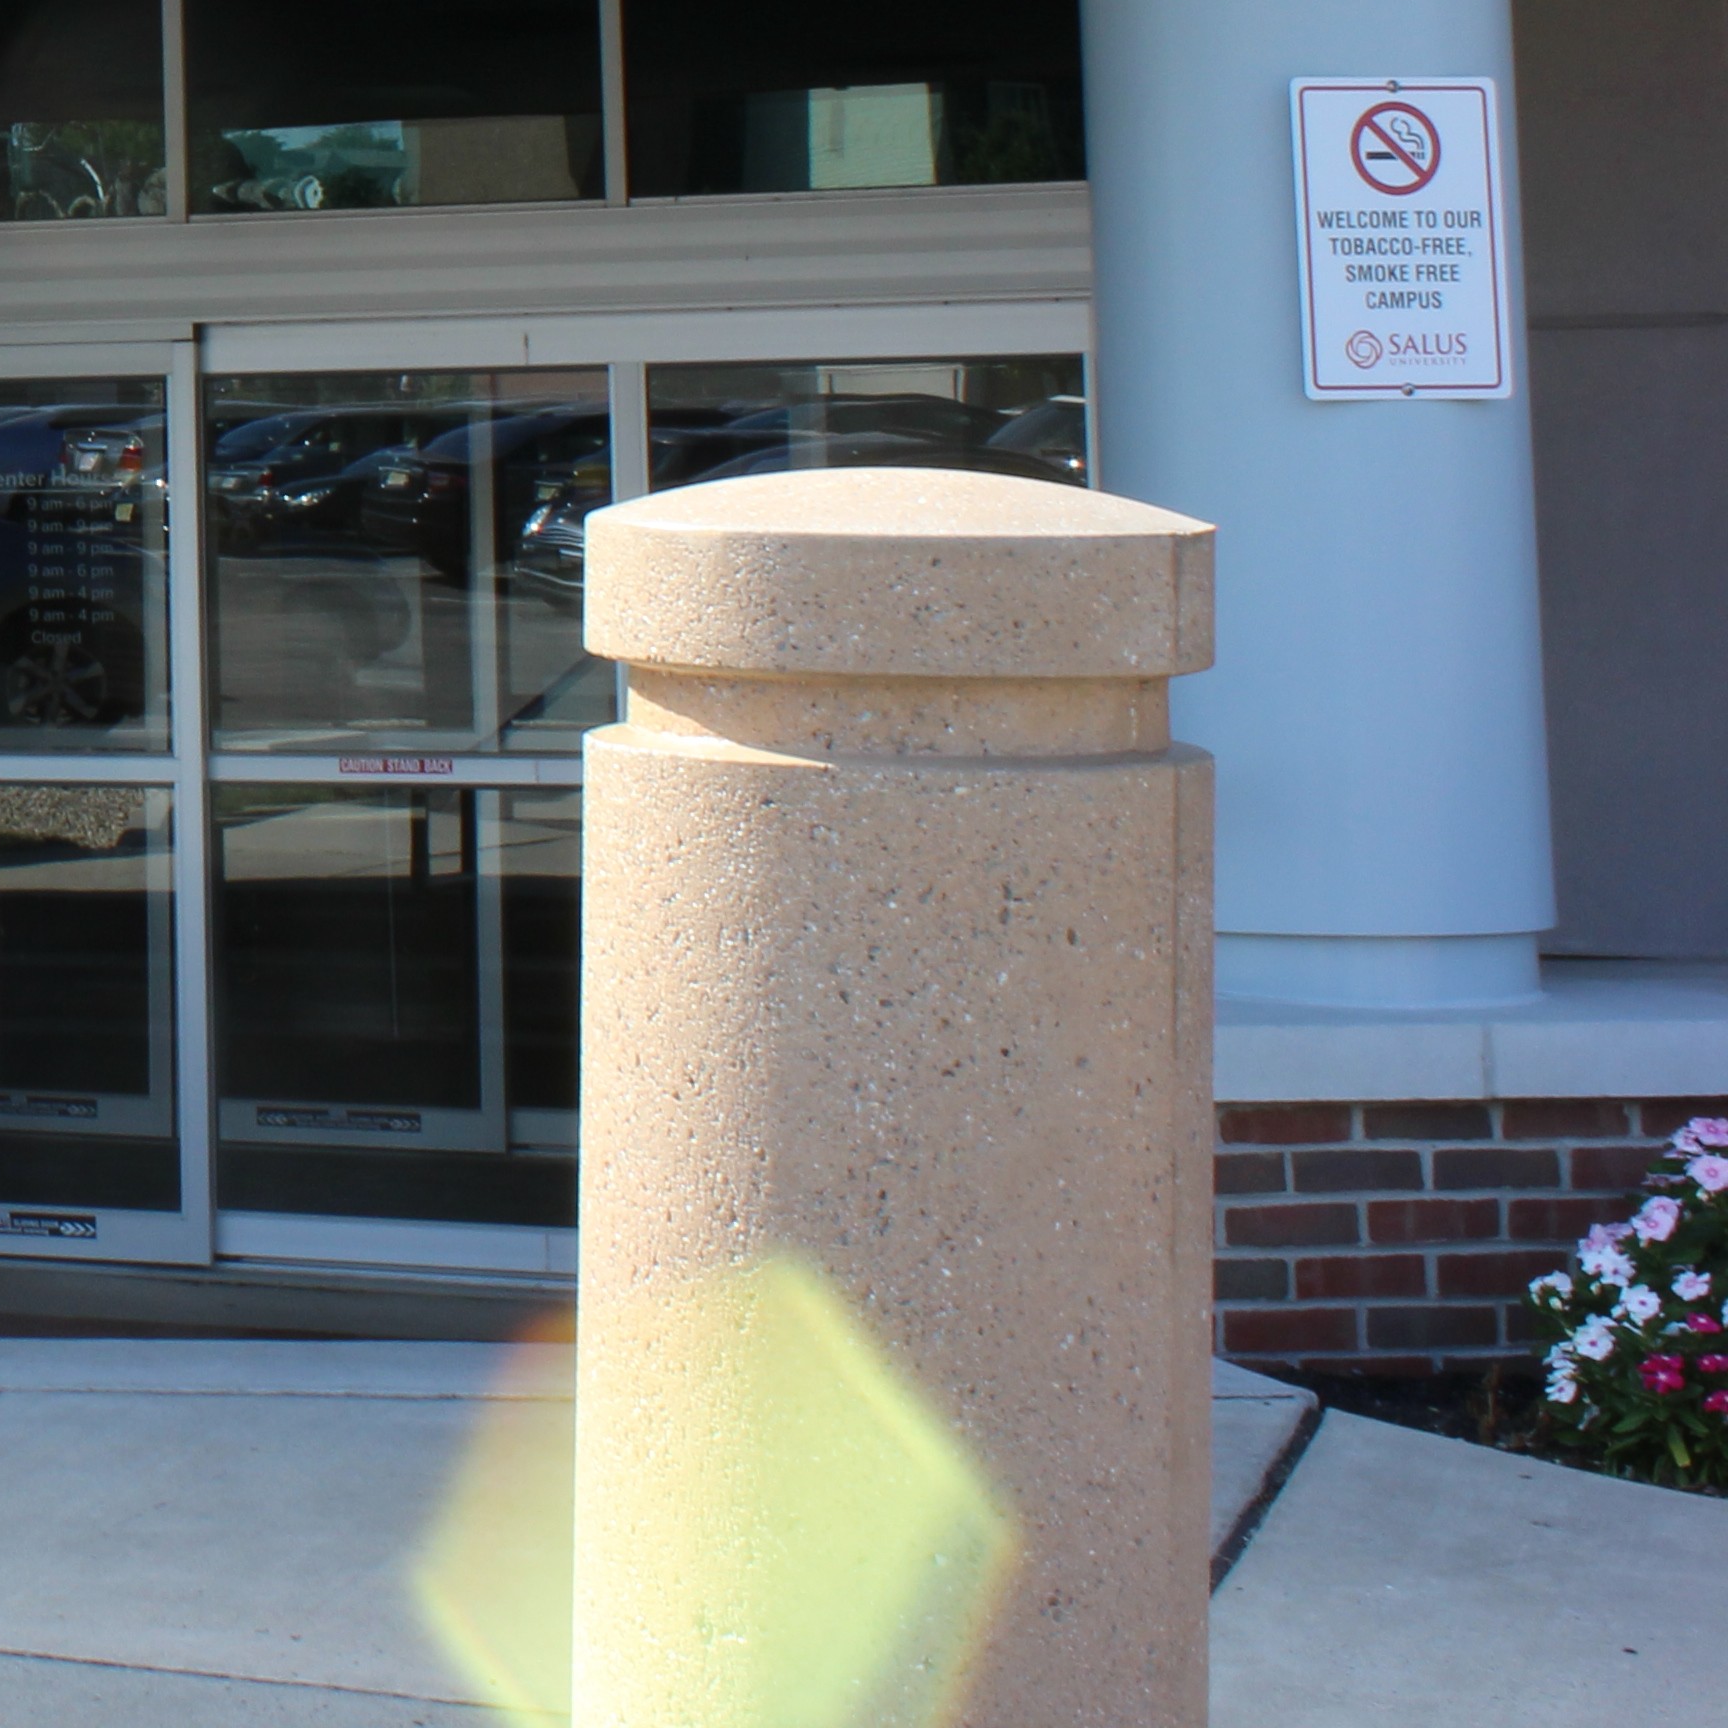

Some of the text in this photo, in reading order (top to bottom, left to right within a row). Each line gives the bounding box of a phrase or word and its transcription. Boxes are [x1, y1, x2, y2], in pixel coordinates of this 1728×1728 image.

[1317, 210, 1482, 229] WELCOME TO OUR
[1329, 237, 1473, 257] TOBACCO-FREE,
[1345, 264, 1461, 283] SMOKE FREE
[1365, 291, 1443, 309] CAMPUS
[1389, 332, 1468, 355] SALUS
[26, 497, 37, 511] 9
[41, 499, 63, 511] am
[27, 519, 38, 533] 9
[41, 521, 64, 533] am
[27, 541, 38, 555] 9
[41, 543, 64, 555] am
[76, 541, 87, 555] 9
[28, 563, 38, 577] 9
[42, 566, 65, 577] am
[90, 566, 114, 580] pm
[28, 585, 39, 600] 9
[42, 588, 65, 599] am
[77, 585, 88, 599] 4
[91, 588, 114, 602] pm
[28, 607, 39, 622] 9
[42, 610, 65, 622] am
[77, 607, 88, 621] 4
[91, 610, 114, 624] pm
[31, 629, 82, 644] Closed
[340, 758, 451, 773] CAUTION STAND BACK
